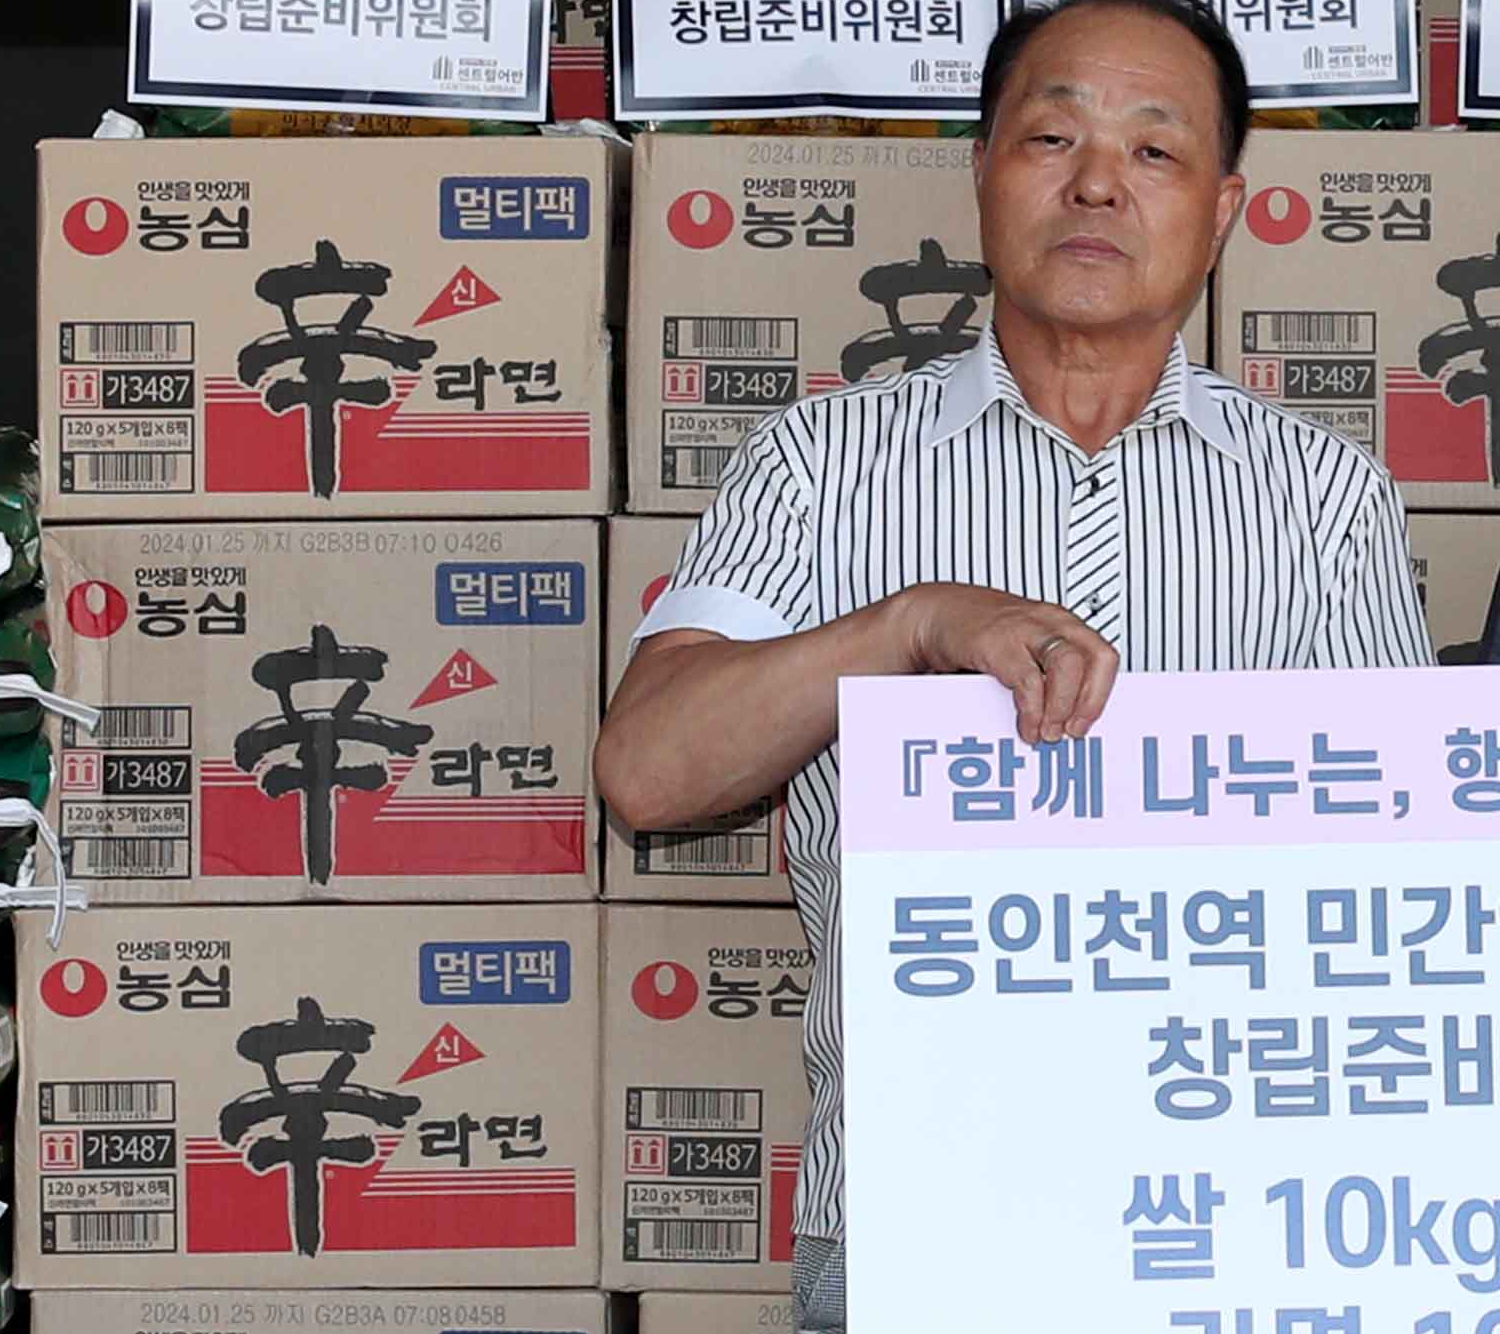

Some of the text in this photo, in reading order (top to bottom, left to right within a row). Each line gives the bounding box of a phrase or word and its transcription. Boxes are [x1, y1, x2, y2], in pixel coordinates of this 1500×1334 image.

[137, 181, 250, 202] 인생을 맛있게
[454, 186, 576, 232] 멀티팩
[136, 204, 250, 251] 농심
[742, 203, 854, 248] 농심
[1320, 197, 1431, 243] 농심
[451, 279, 476, 306] 신
[106, 374, 190, 405] 가3487
[238, 239, 437, 499] 辛
[434, 357, 562, 411] 라면
[708, 370, 793, 400] 가3487
[1289, 365, 1370, 395] 가3487
[135, 592, 246, 637] 농심
[449, 571, 572, 617] 멀티팩
[107, 759, 187, 789] 가3487
[430, 742, 558, 796] 라면
[1143, 733, 1410, 820] 나누는,
[889, 889, 1266, 997] 동인천역
[116, 965, 230, 1011] 농심
[433, 950, 556, 995] 멀티팩
[86, 1135, 170, 1164] 가3487
[219, 996, 421, 1258] 辛
[418, 1113, 548, 1167] 라면
[671, 1140, 758, 1173] 가3487
[1122, 1172, 1225, 1281] 쌀
